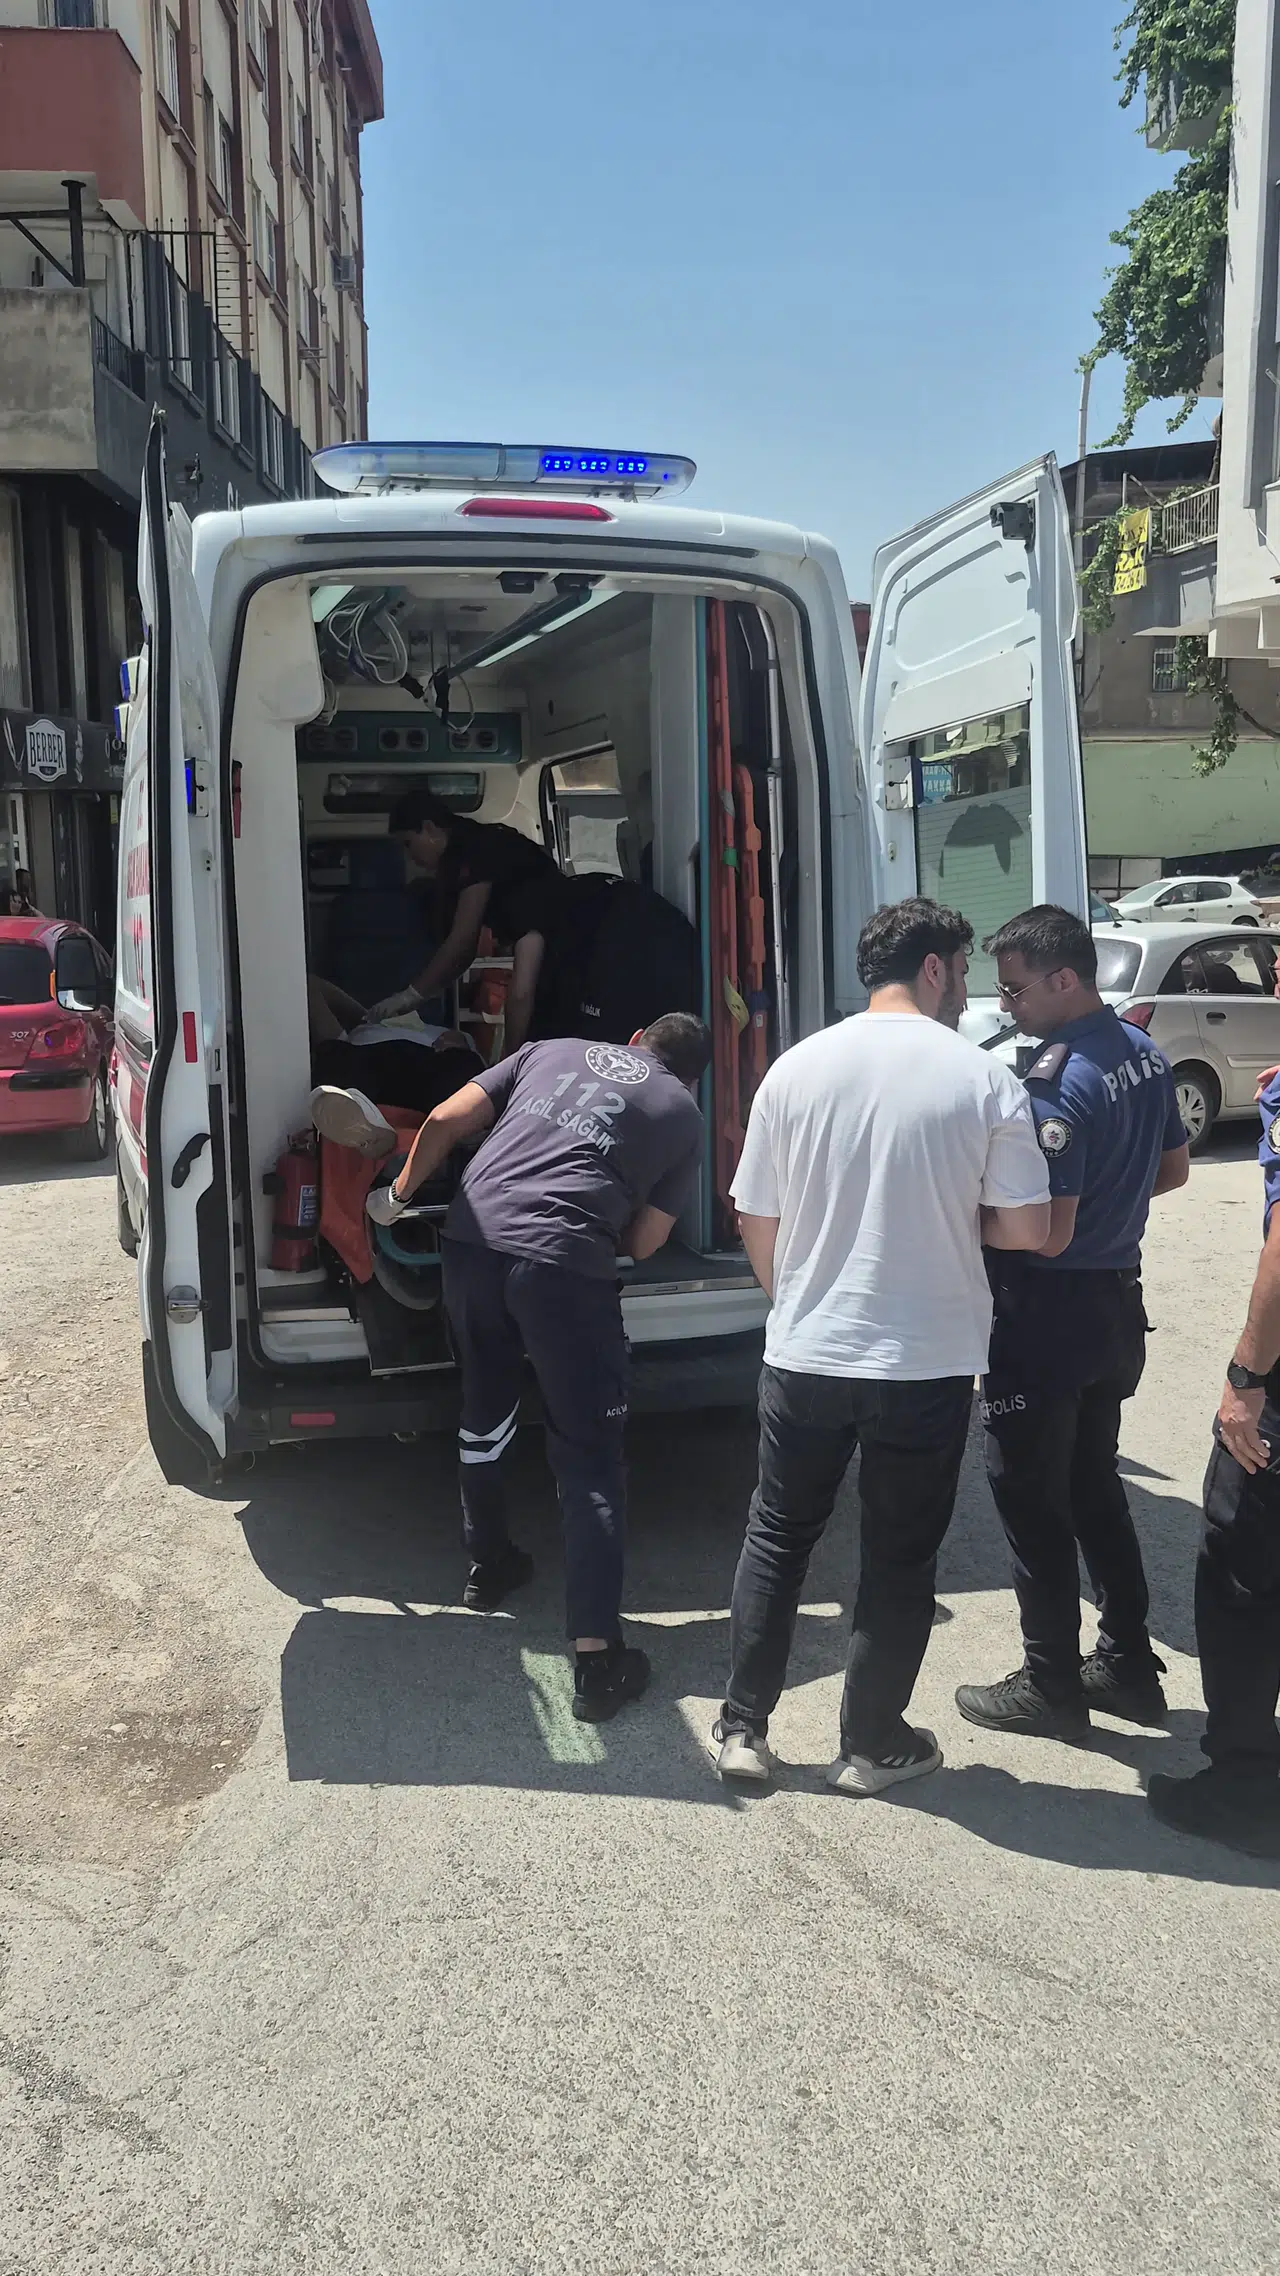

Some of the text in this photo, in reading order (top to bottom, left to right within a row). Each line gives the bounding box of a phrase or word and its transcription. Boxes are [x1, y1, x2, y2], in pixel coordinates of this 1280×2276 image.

[29, 731, 64, 769] BERBER
[10, 1031, 29, 1039] 307
[553, 1071, 626, 1127] 112
[518, 1096, 616, 1156] ACİL SAĞLIK
